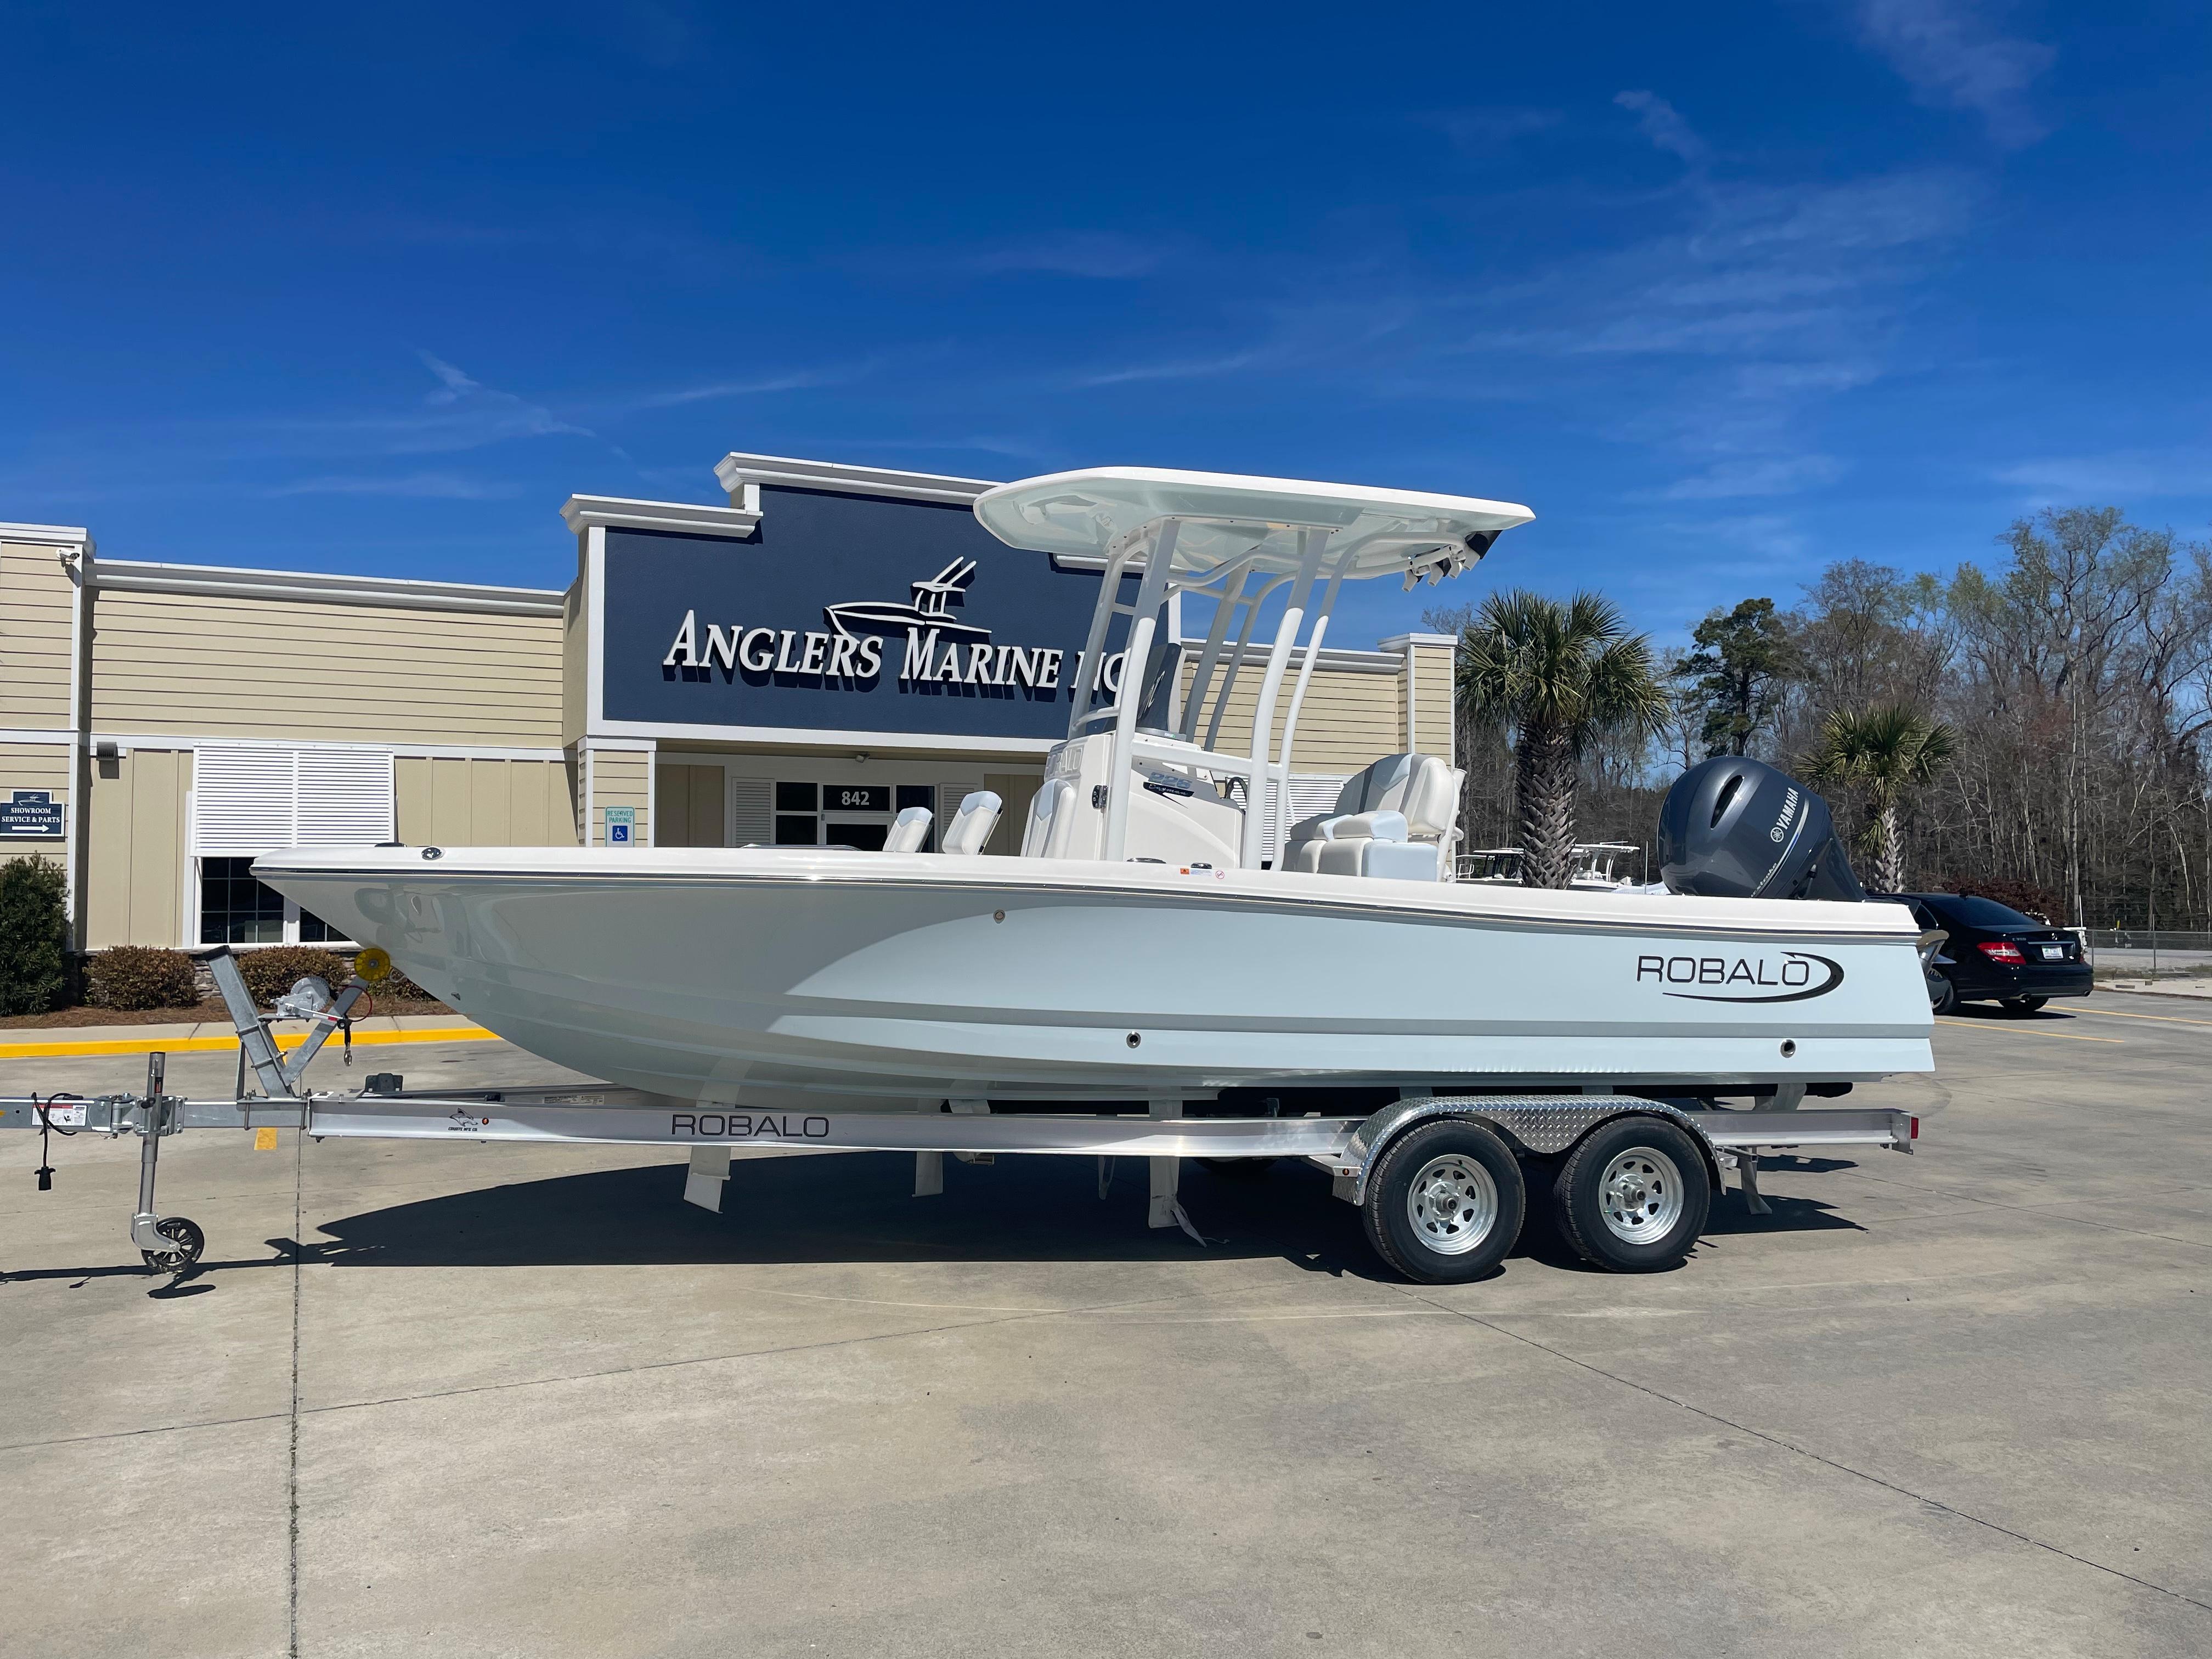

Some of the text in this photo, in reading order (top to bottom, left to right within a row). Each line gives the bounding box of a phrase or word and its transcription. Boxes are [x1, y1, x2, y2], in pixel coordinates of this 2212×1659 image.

[663, 609, 884, 678] ANGLERS
[900, 627, 1063, 688] MARINE
[842, 791, 870, 805] 842
[1776, 787, 1799, 830] YAMAHA
[1637, 955, 1809, 986] ROBALO
[672, 1114, 829, 1137] ROBALO
